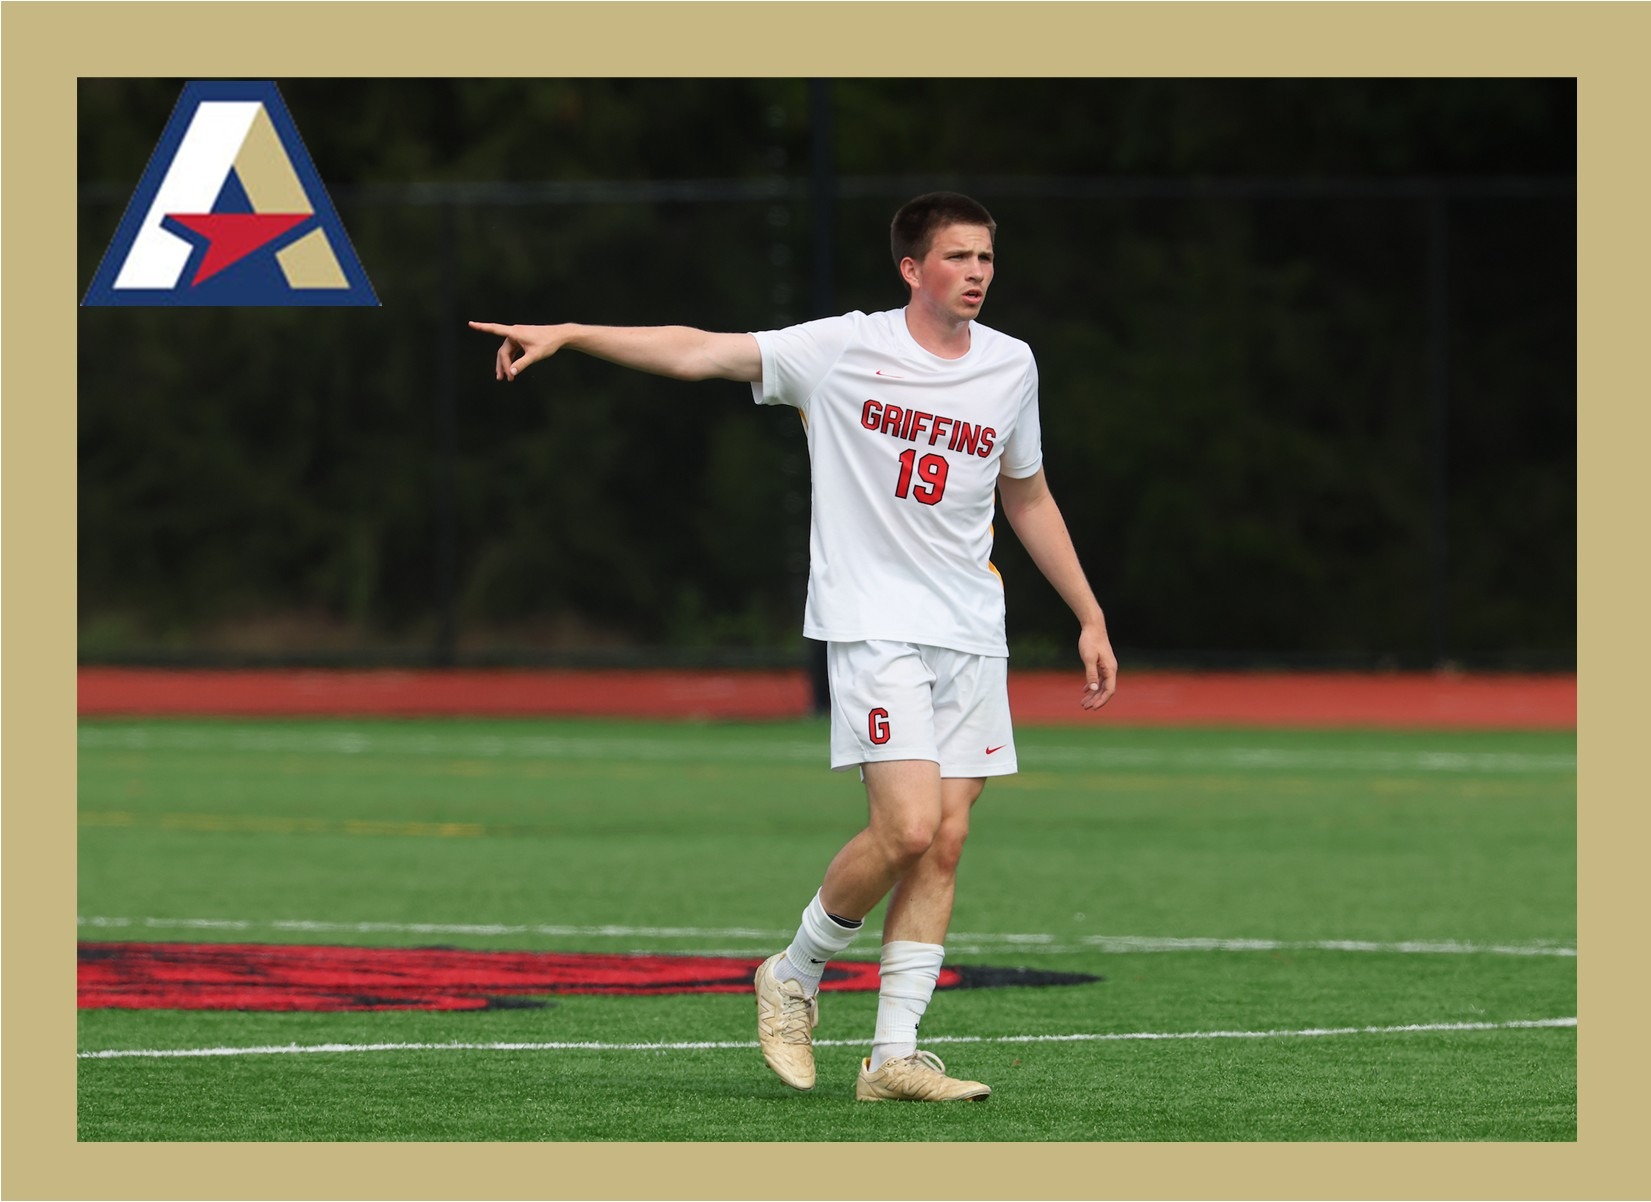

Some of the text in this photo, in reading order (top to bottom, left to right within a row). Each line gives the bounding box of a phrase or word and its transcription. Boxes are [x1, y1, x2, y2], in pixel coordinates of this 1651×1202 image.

[861, 399, 997, 458] GRIFFINS
[895, 448, 949, 506] 19
[868, 707, 891, 745] G
